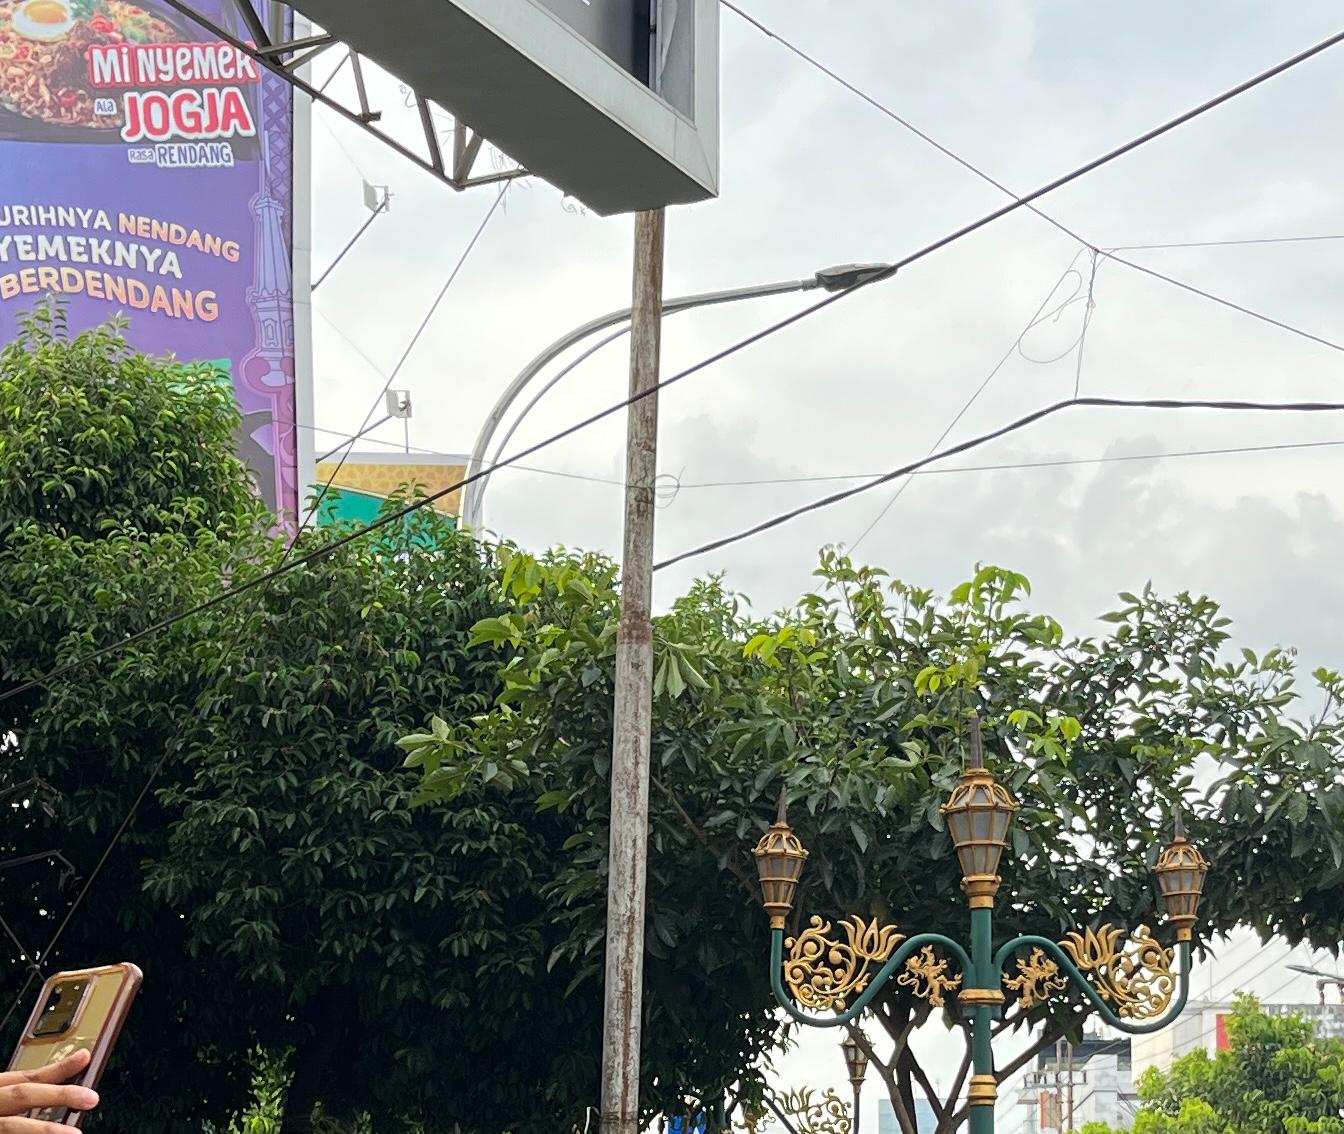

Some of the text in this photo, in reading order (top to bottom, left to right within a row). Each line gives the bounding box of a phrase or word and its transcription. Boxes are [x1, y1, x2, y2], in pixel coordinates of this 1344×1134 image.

[126, 91, 251, 138] JOGJA
[158, 145, 232, 165] RENDANG
[118, 212, 241, 263] NENDANG
